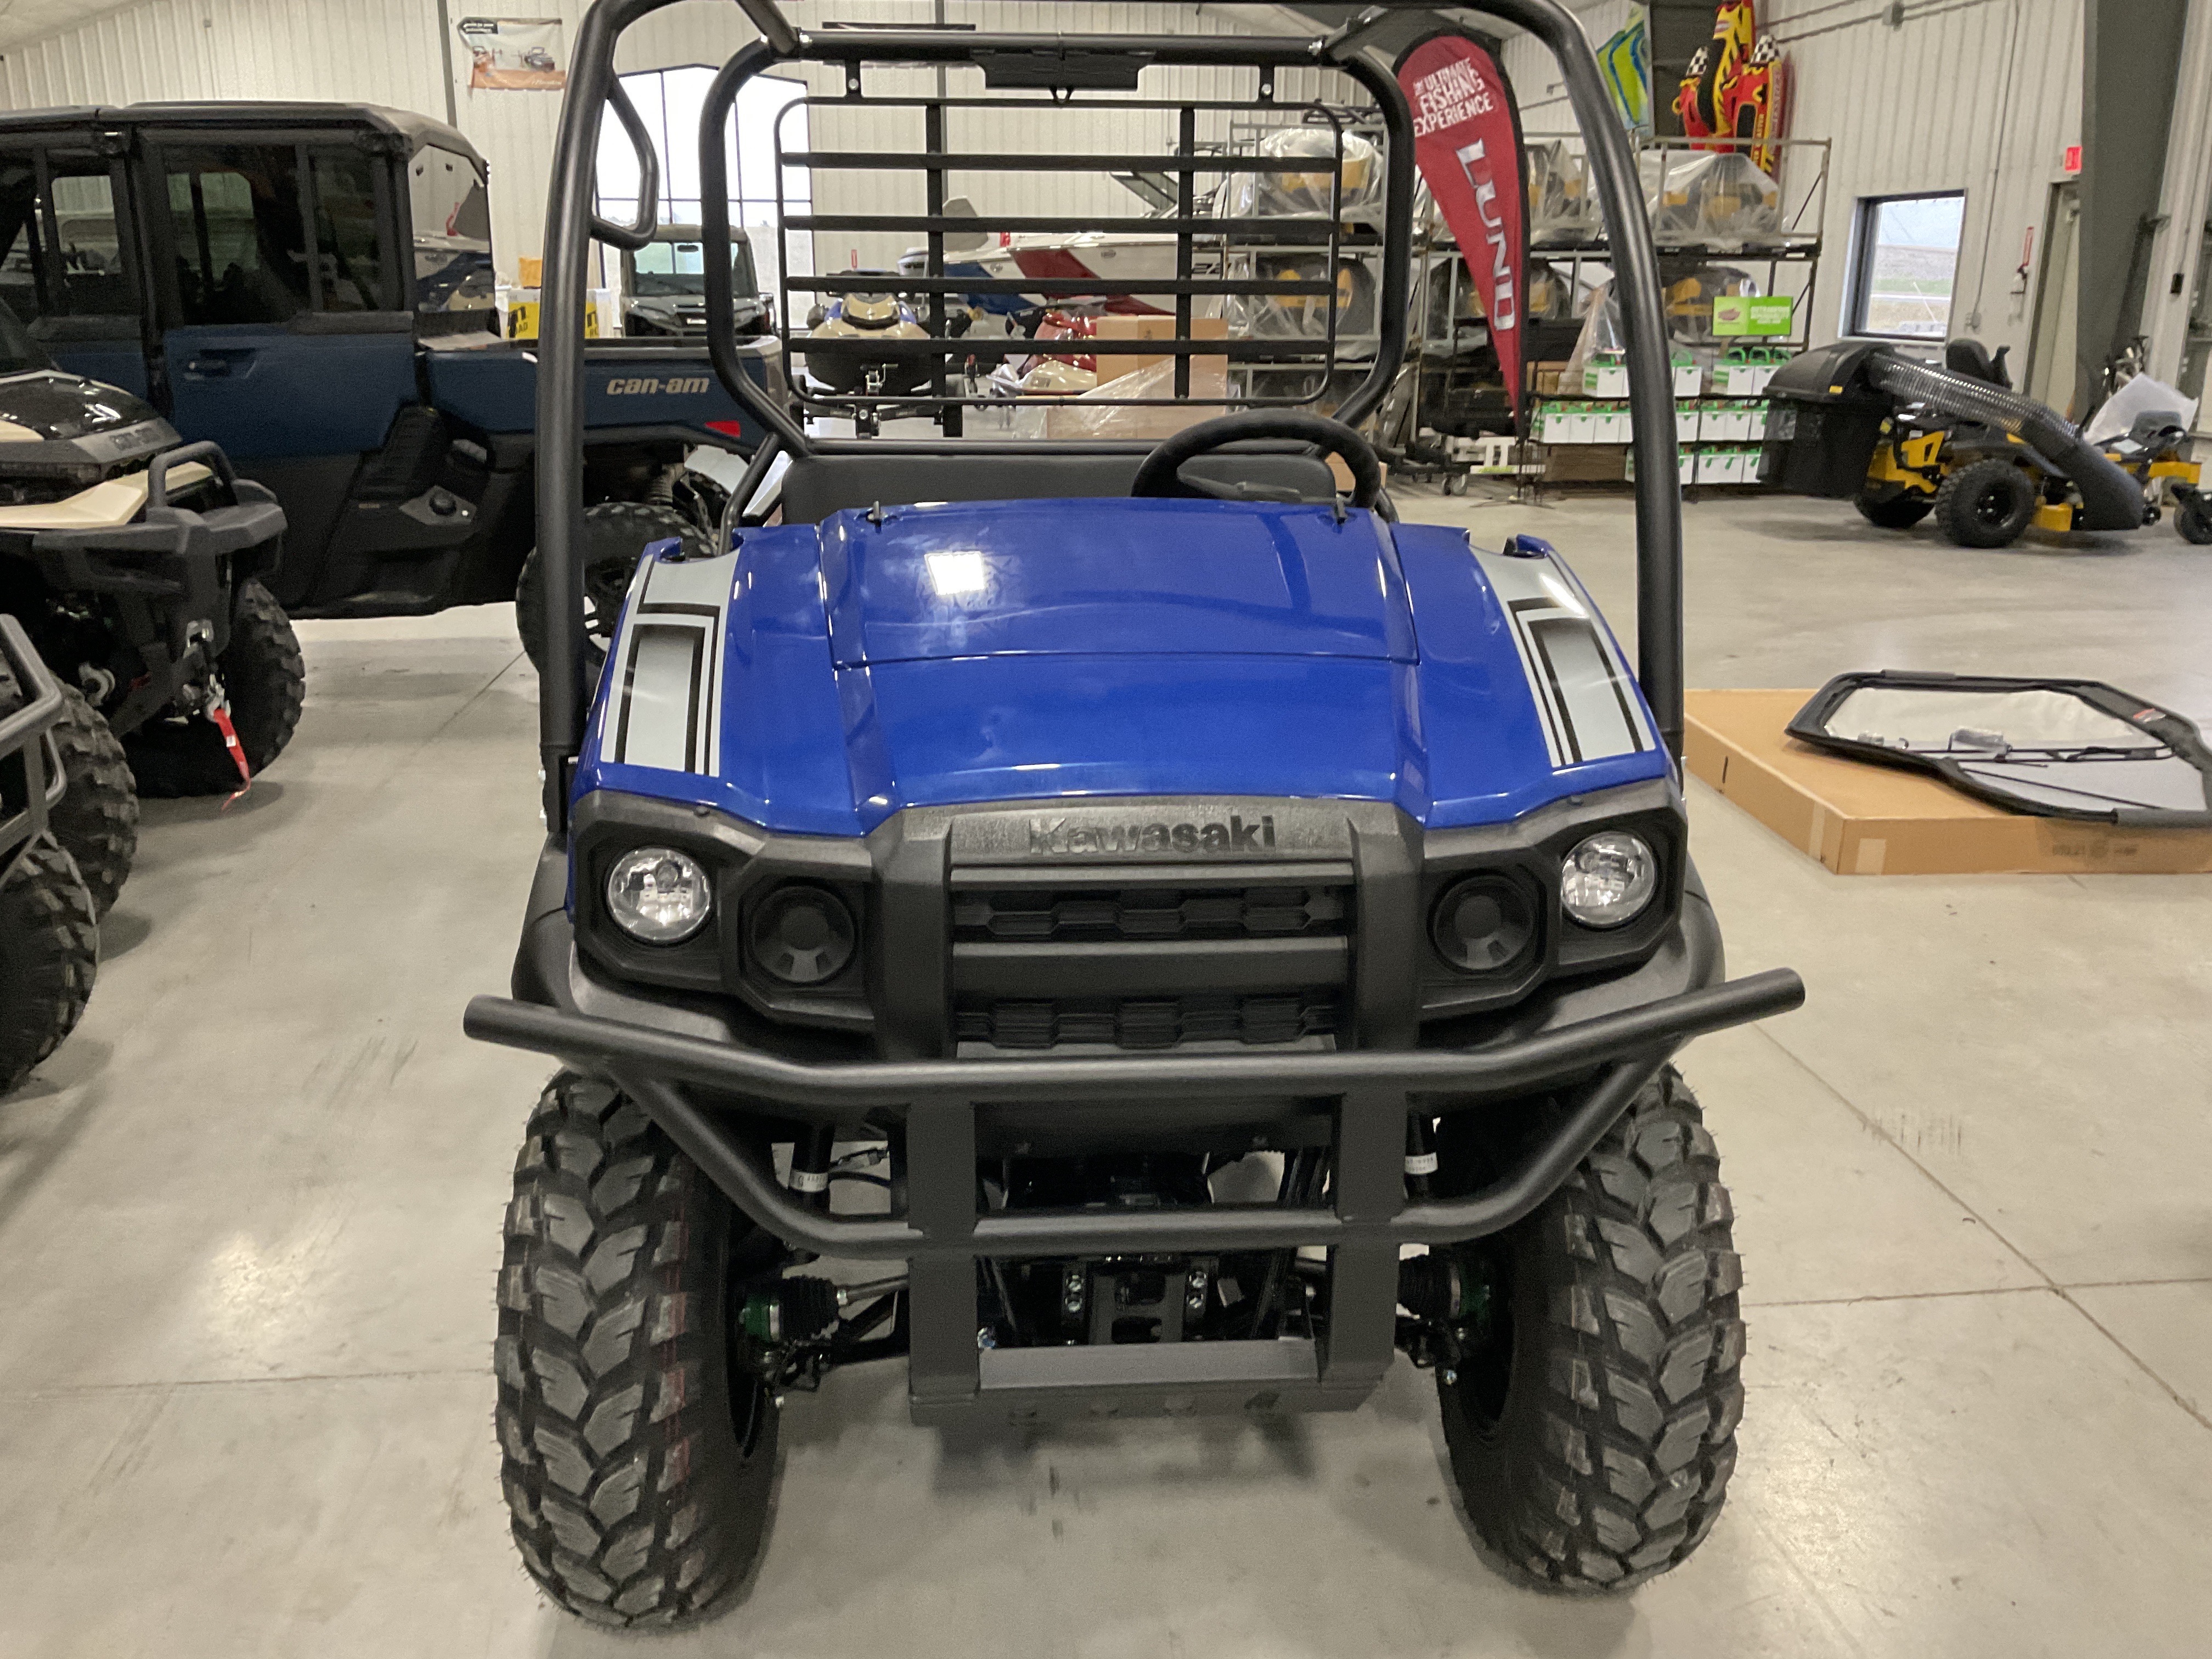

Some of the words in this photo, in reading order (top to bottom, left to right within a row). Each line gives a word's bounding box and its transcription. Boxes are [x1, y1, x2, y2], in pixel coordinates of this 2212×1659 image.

[1420, 68, 1485, 114] FISHING
[1424, 57, 1472, 91] ULTIMATE
[1413, 92, 1494, 137] EXPERIENCE
[1455, 137, 1515, 330] LUND
[606, 377, 709, 395] can-am
[1029, 814, 1276, 854] Kawasaki
